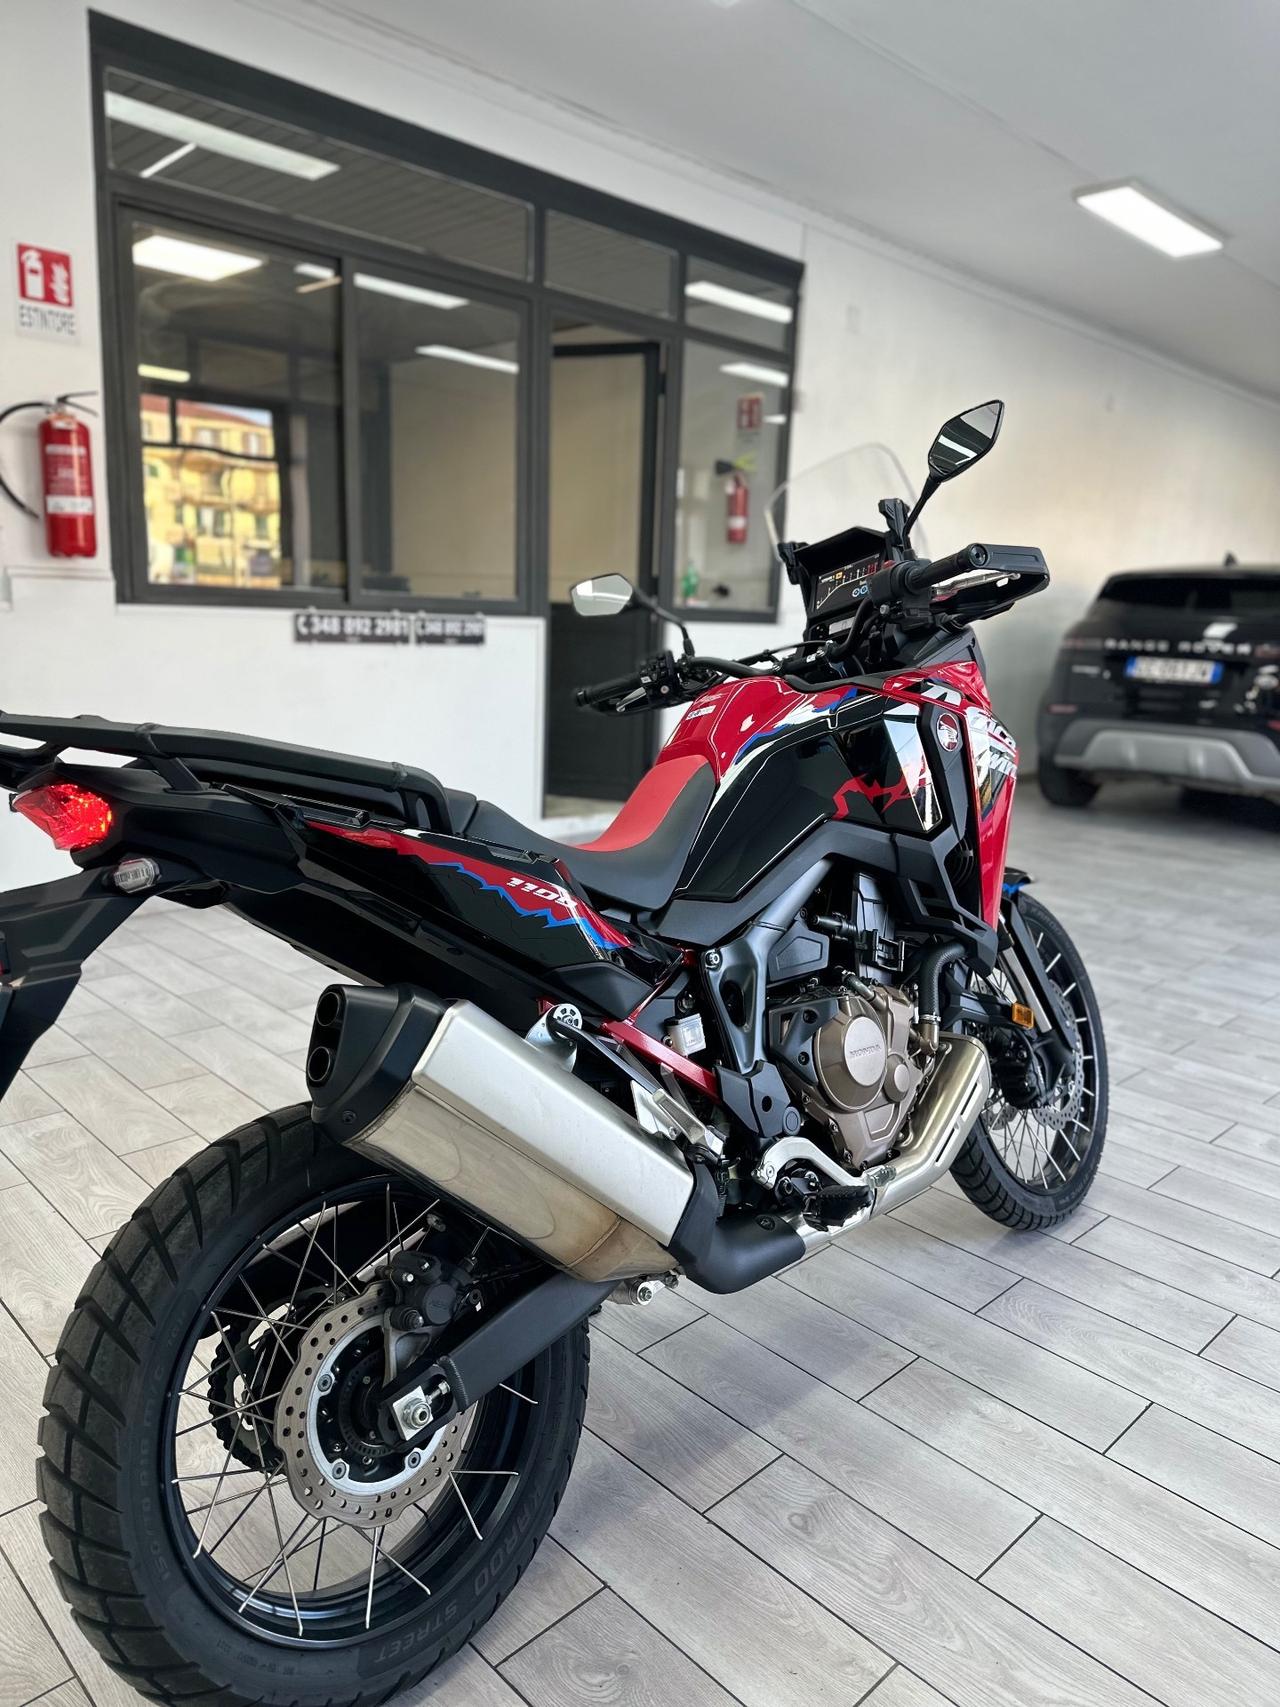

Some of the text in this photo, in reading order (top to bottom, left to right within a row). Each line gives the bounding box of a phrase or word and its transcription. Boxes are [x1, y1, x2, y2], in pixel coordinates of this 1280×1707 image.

[1103, 638, 1170, 652] RANGE
[849, 1043, 882, 1057] HONDA
[375, 1600, 459, 1664] STREET
